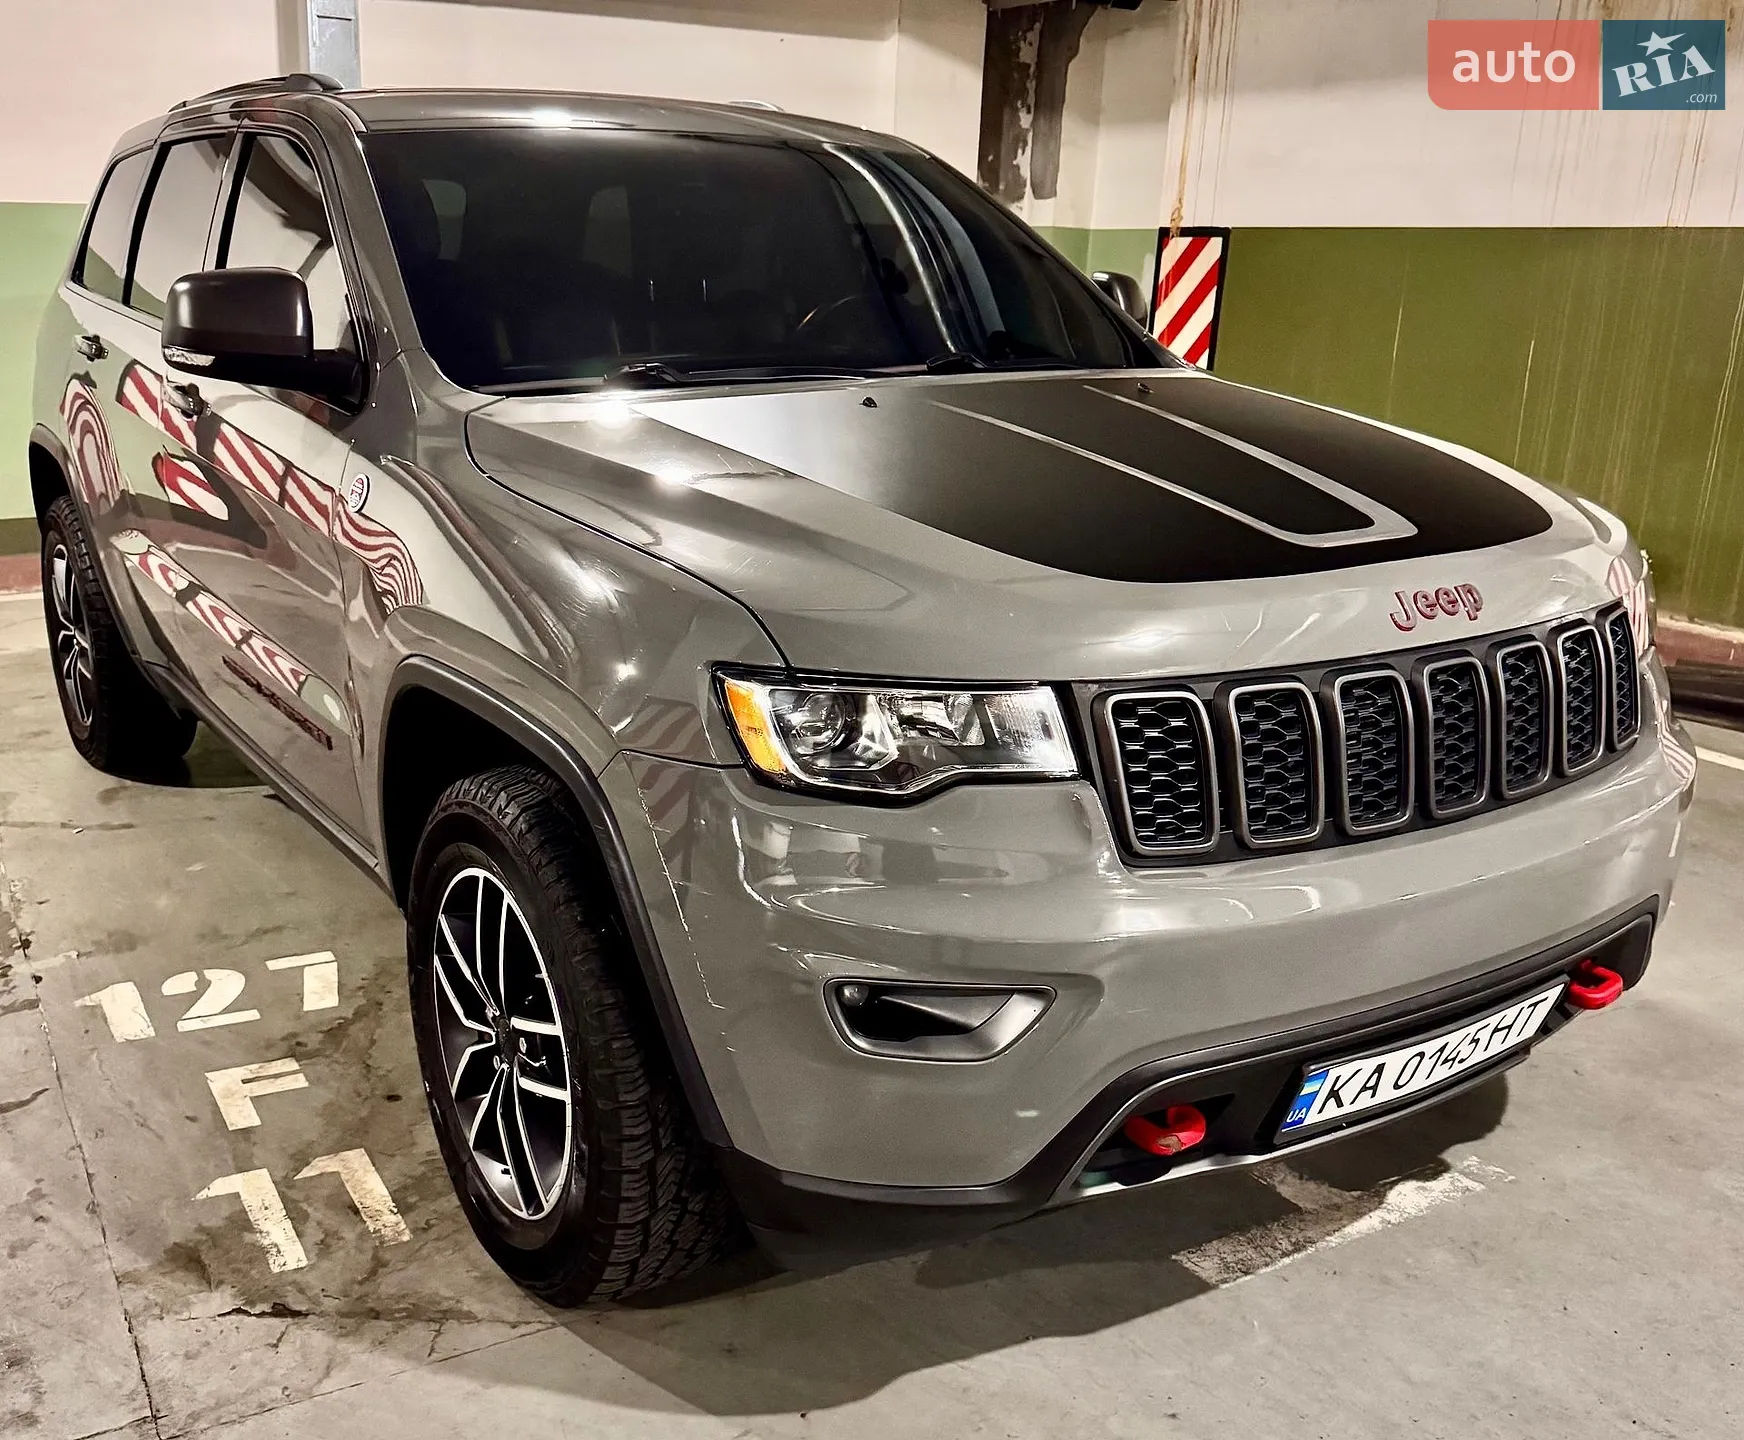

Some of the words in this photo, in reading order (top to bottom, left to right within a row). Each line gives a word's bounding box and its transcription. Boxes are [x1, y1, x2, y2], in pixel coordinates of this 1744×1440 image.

[1389, 583, 1484, 632] Jeep
[74, 950, 340, 1043] 127
[204, 1057, 310, 1131] F
[1286, 1107, 1307, 1123] UA
